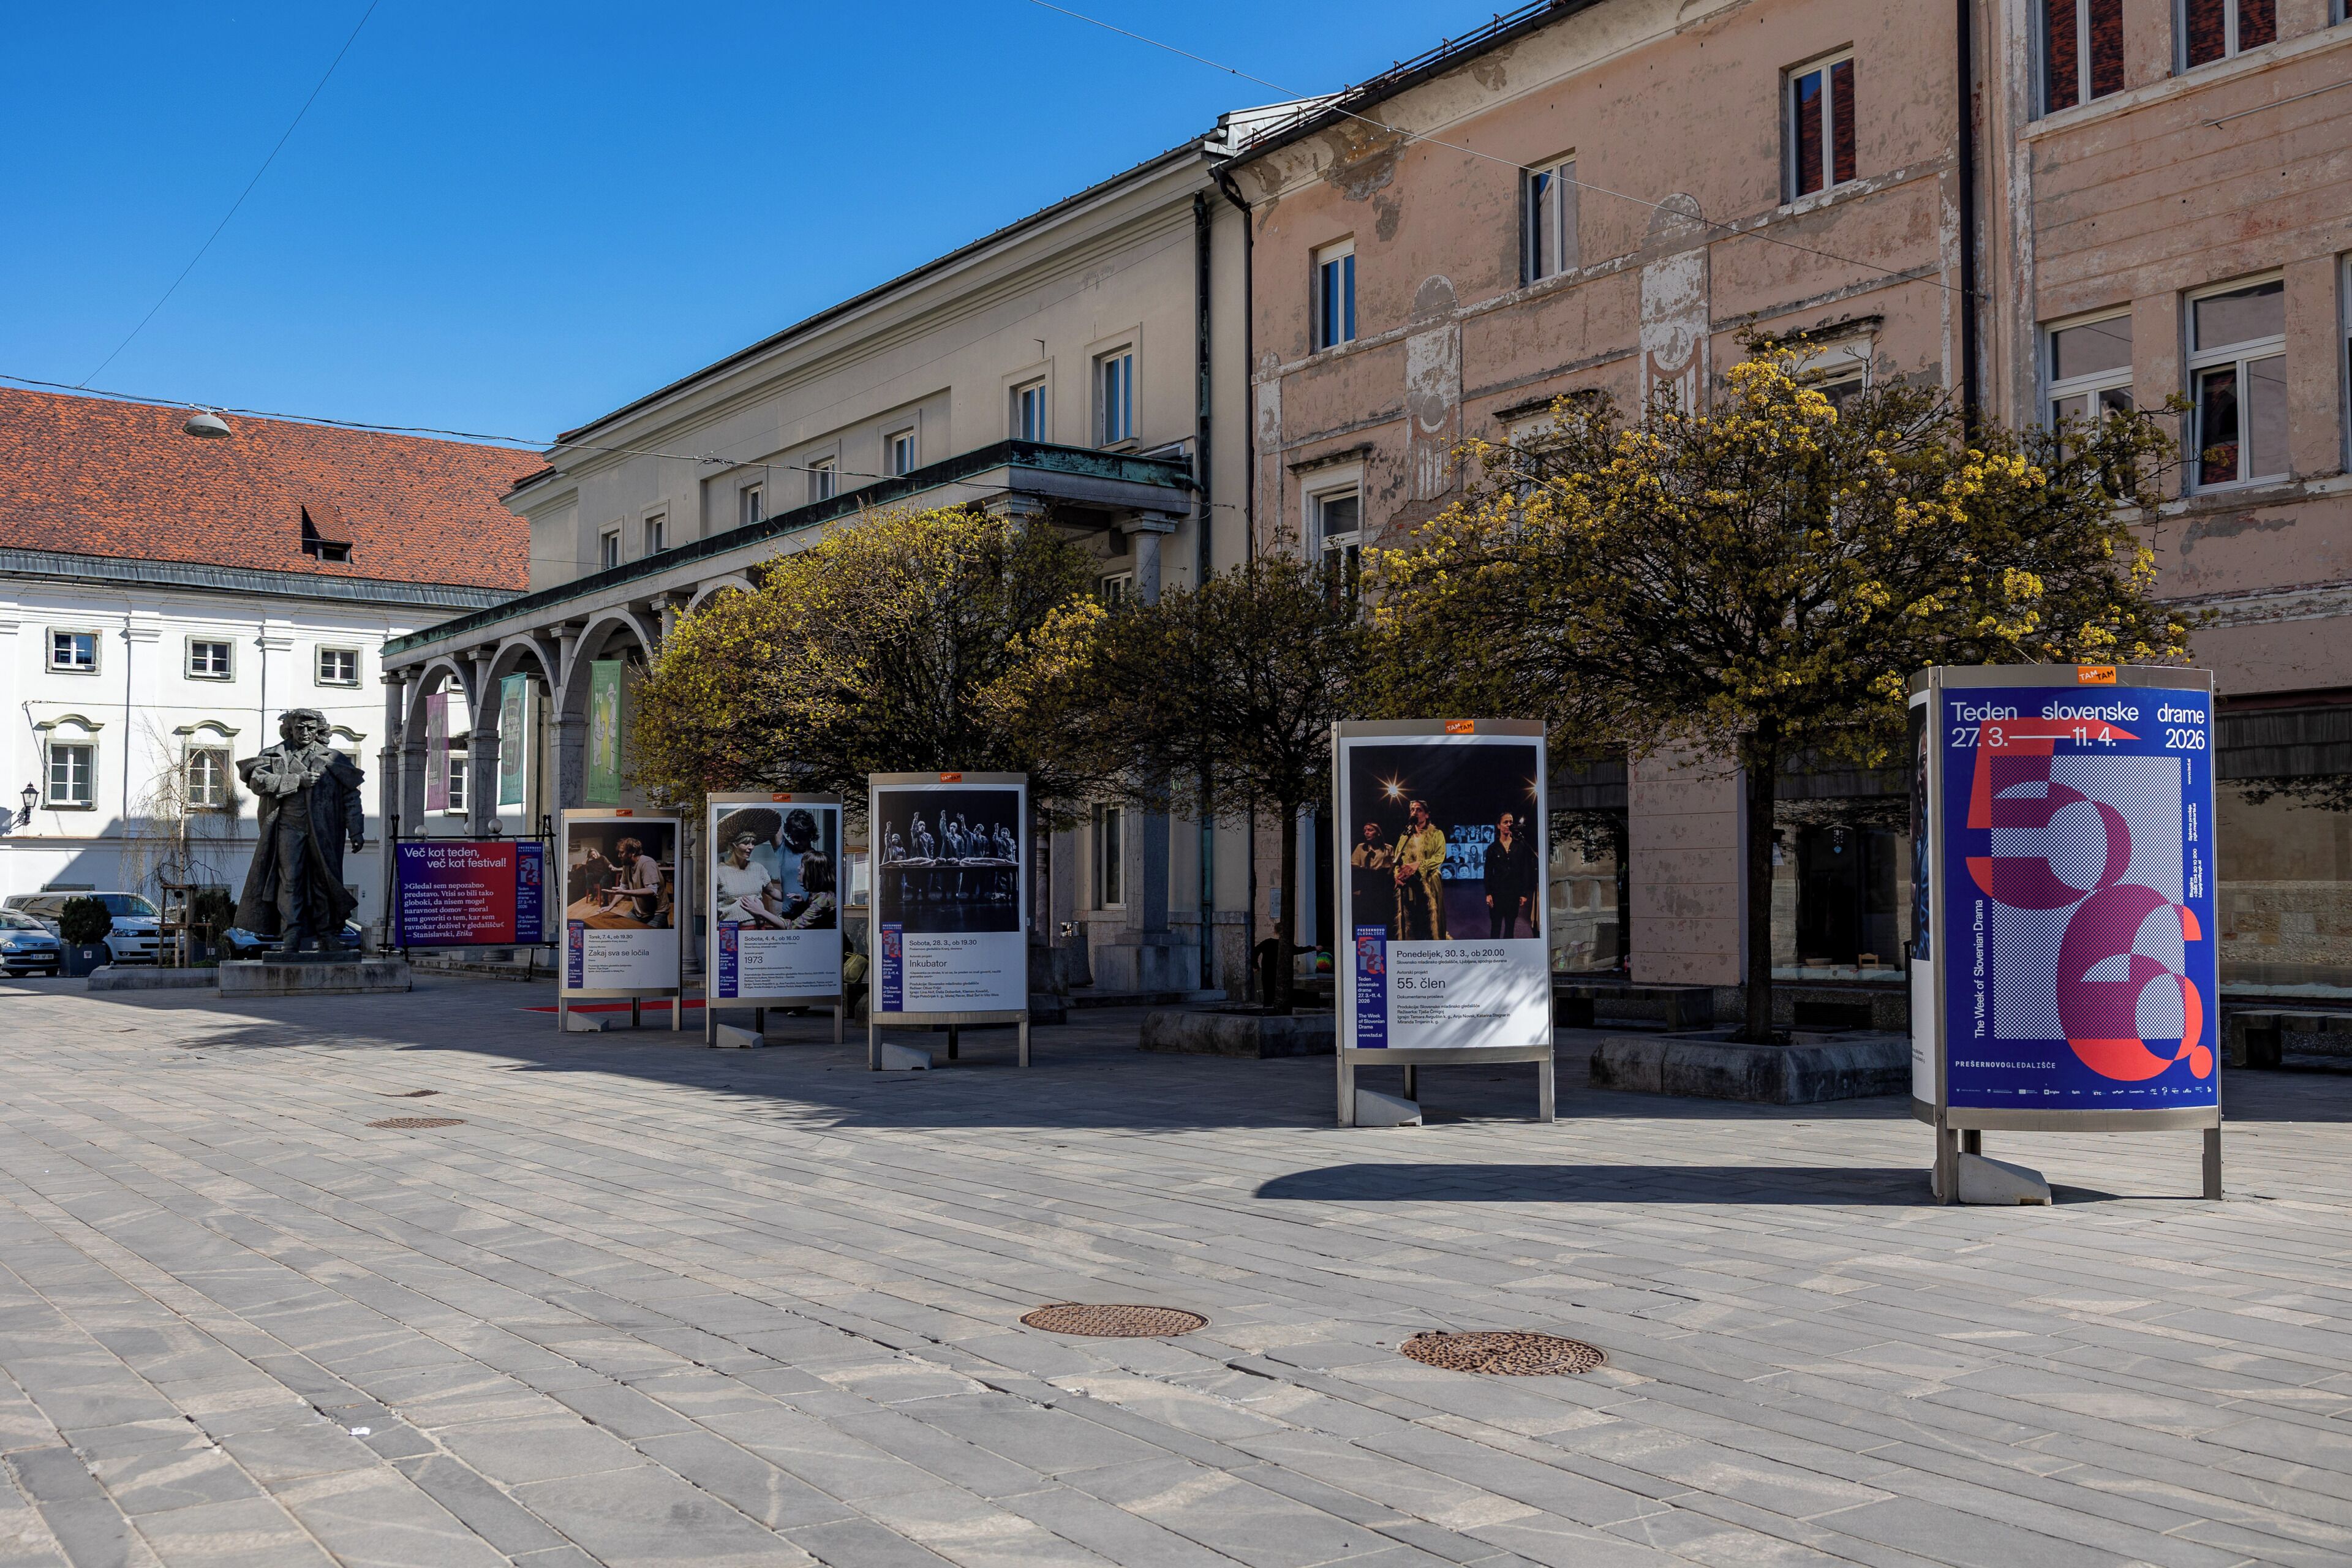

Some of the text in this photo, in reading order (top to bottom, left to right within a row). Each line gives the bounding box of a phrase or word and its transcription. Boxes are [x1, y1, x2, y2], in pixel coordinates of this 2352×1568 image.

[2079, 670, 2114, 680] TAM TAM
[595, 693, 603, 704] PU
[1950, 701, 2204, 725] Teden slovenske drame
[1447, 723, 1460, 731] TAM
[1951, 727, 1981, 747] 27.
[2097, 726, 2116, 747] 4.
[2165, 729, 2204, 750] 2026
[404, 847, 480, 858] Več kot teden,
[427, 858, 507, 868] več kot festival!
[420, 915, 445, 924] govoriti
[1396, 951, 1443, 959] Ponedeljek,
[1460, 949, 1469, 958] 3.,
[1973, 900, 1985, 1038] The Week of Slovenian Drama
[1397, 978, 1446, 989] 55. člen
